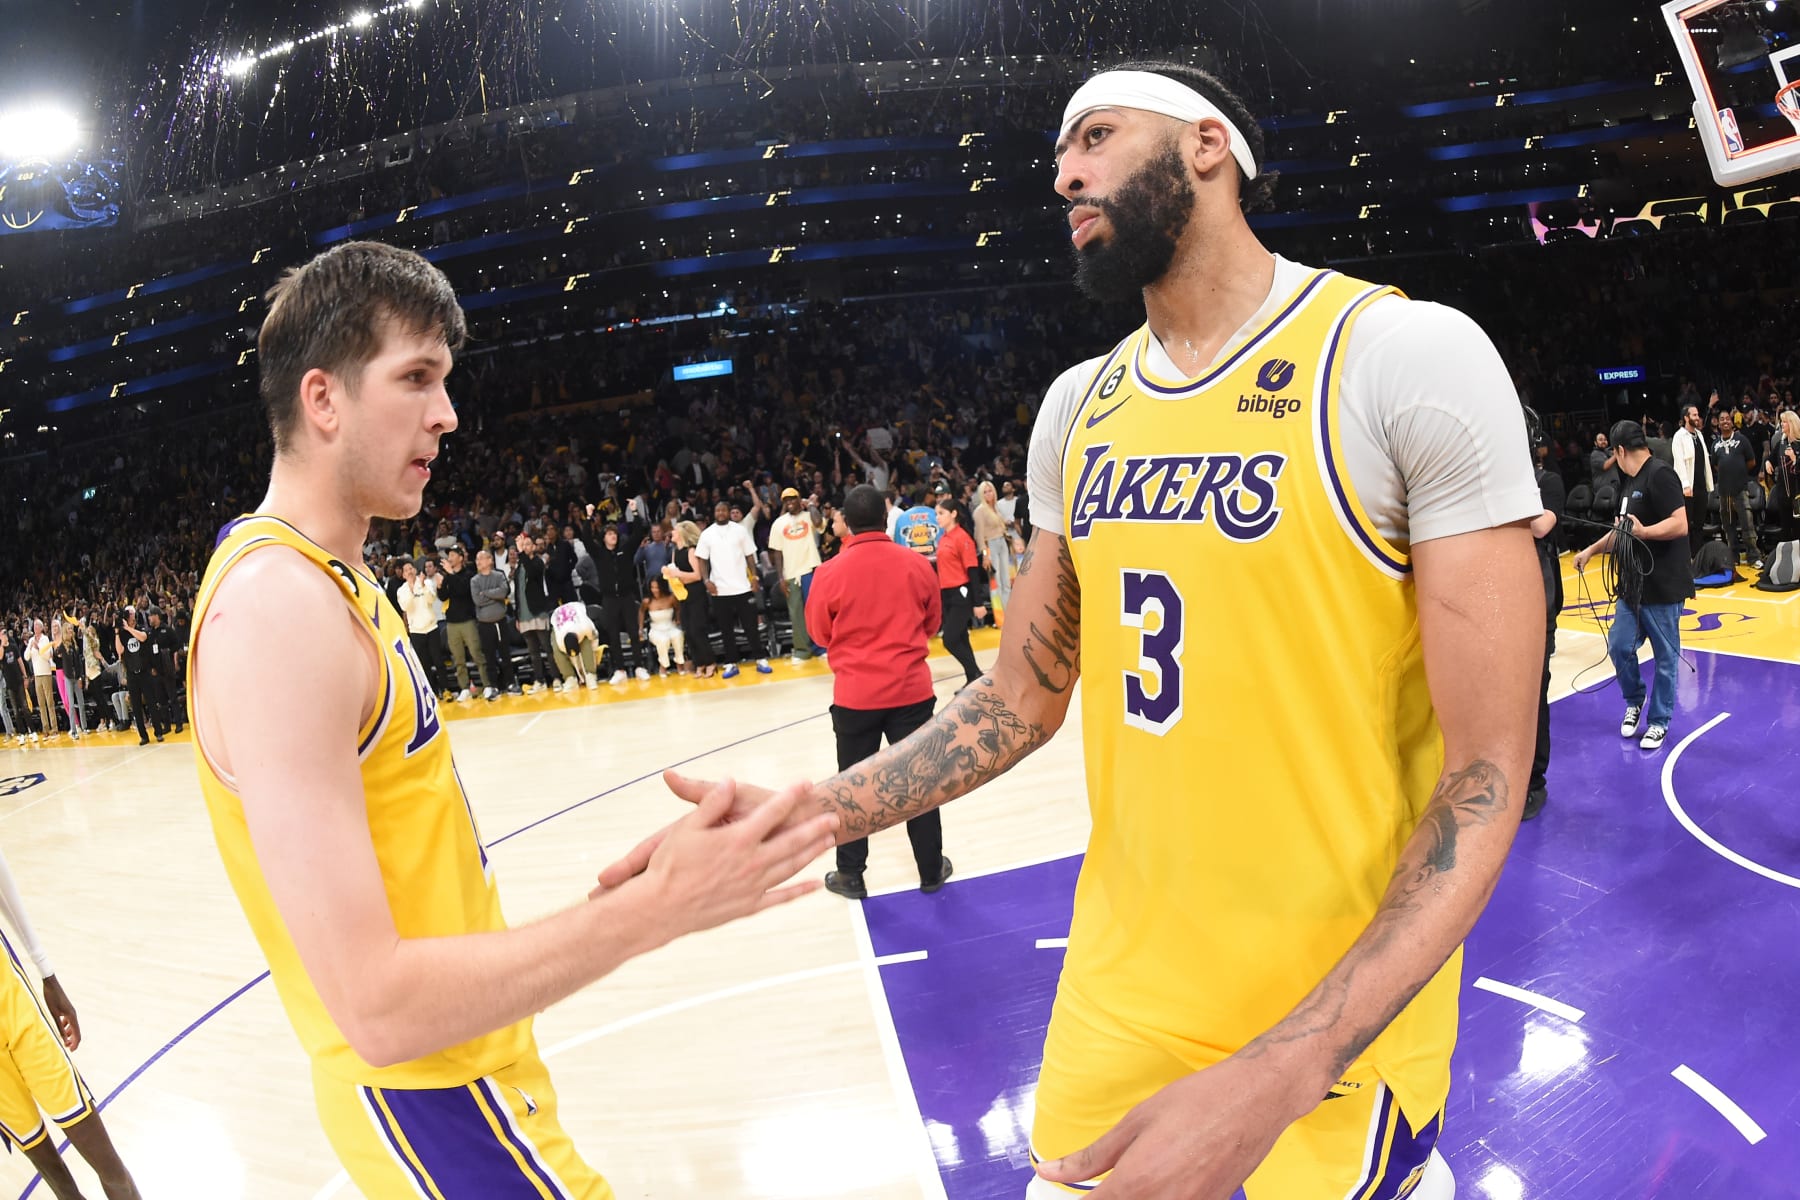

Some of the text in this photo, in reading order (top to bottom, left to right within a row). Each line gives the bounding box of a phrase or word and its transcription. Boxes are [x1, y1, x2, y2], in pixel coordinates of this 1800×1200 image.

[1102, 368, 1122, 396] 6
[1603, 370, 1639, 380] EXPRESS
[1237, 394, 1301, 419] bibigo
[1071, 442, 1287, 542] LAKERS
[1120, 568, 1184, 737] 3
